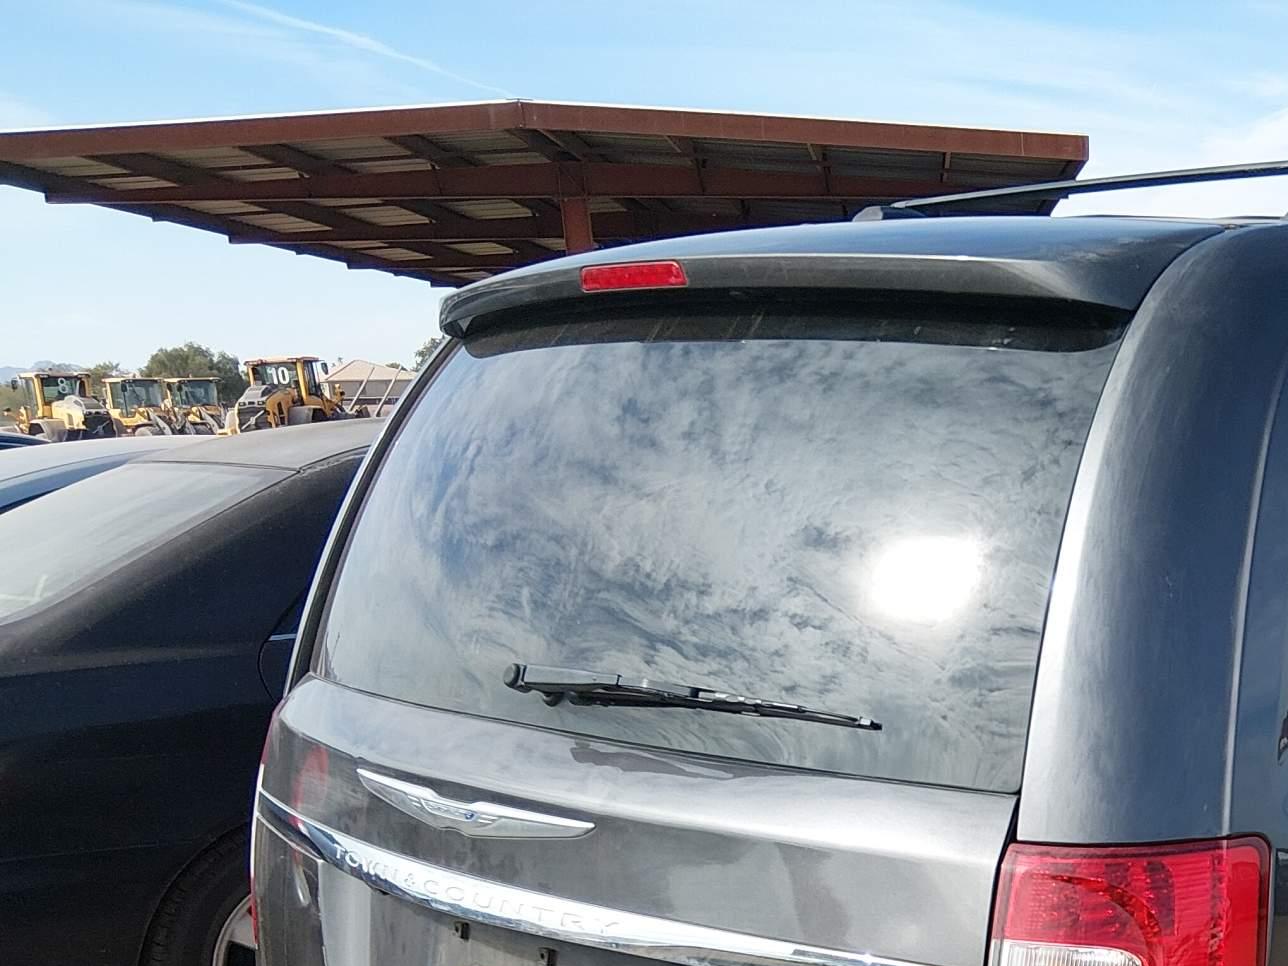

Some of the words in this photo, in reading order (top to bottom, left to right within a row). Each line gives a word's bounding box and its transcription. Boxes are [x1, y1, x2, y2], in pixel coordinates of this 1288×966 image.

[57, 377, 68, 393] 8
[271, 366, 290, 385] 10
[423, 878, 621, 935] COUNTRY
